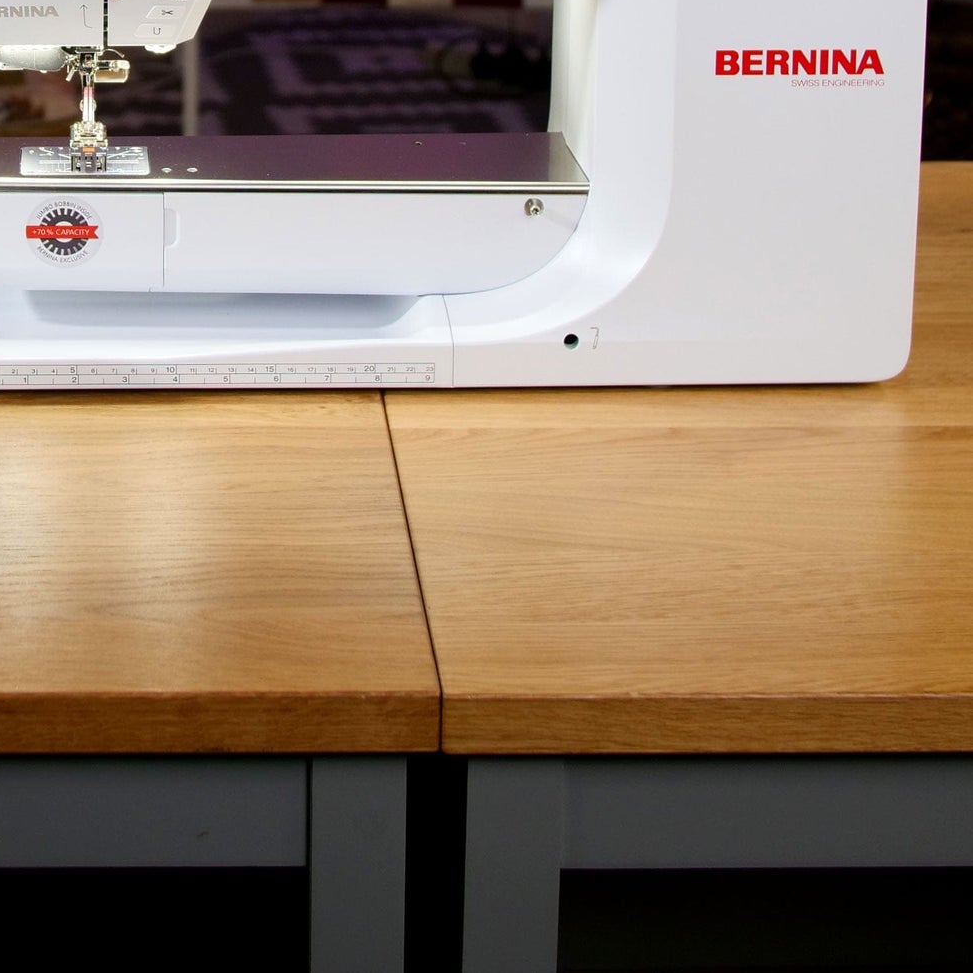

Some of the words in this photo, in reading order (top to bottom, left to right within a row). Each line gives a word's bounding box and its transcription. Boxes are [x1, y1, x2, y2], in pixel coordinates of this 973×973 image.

[714, 49, 885, 76] BERNINA
[791, 78, 820, 87] SWISS
[822, 78, 885, 87] ENGINEERING
[55, 228, 90, 236] CAPACITY
